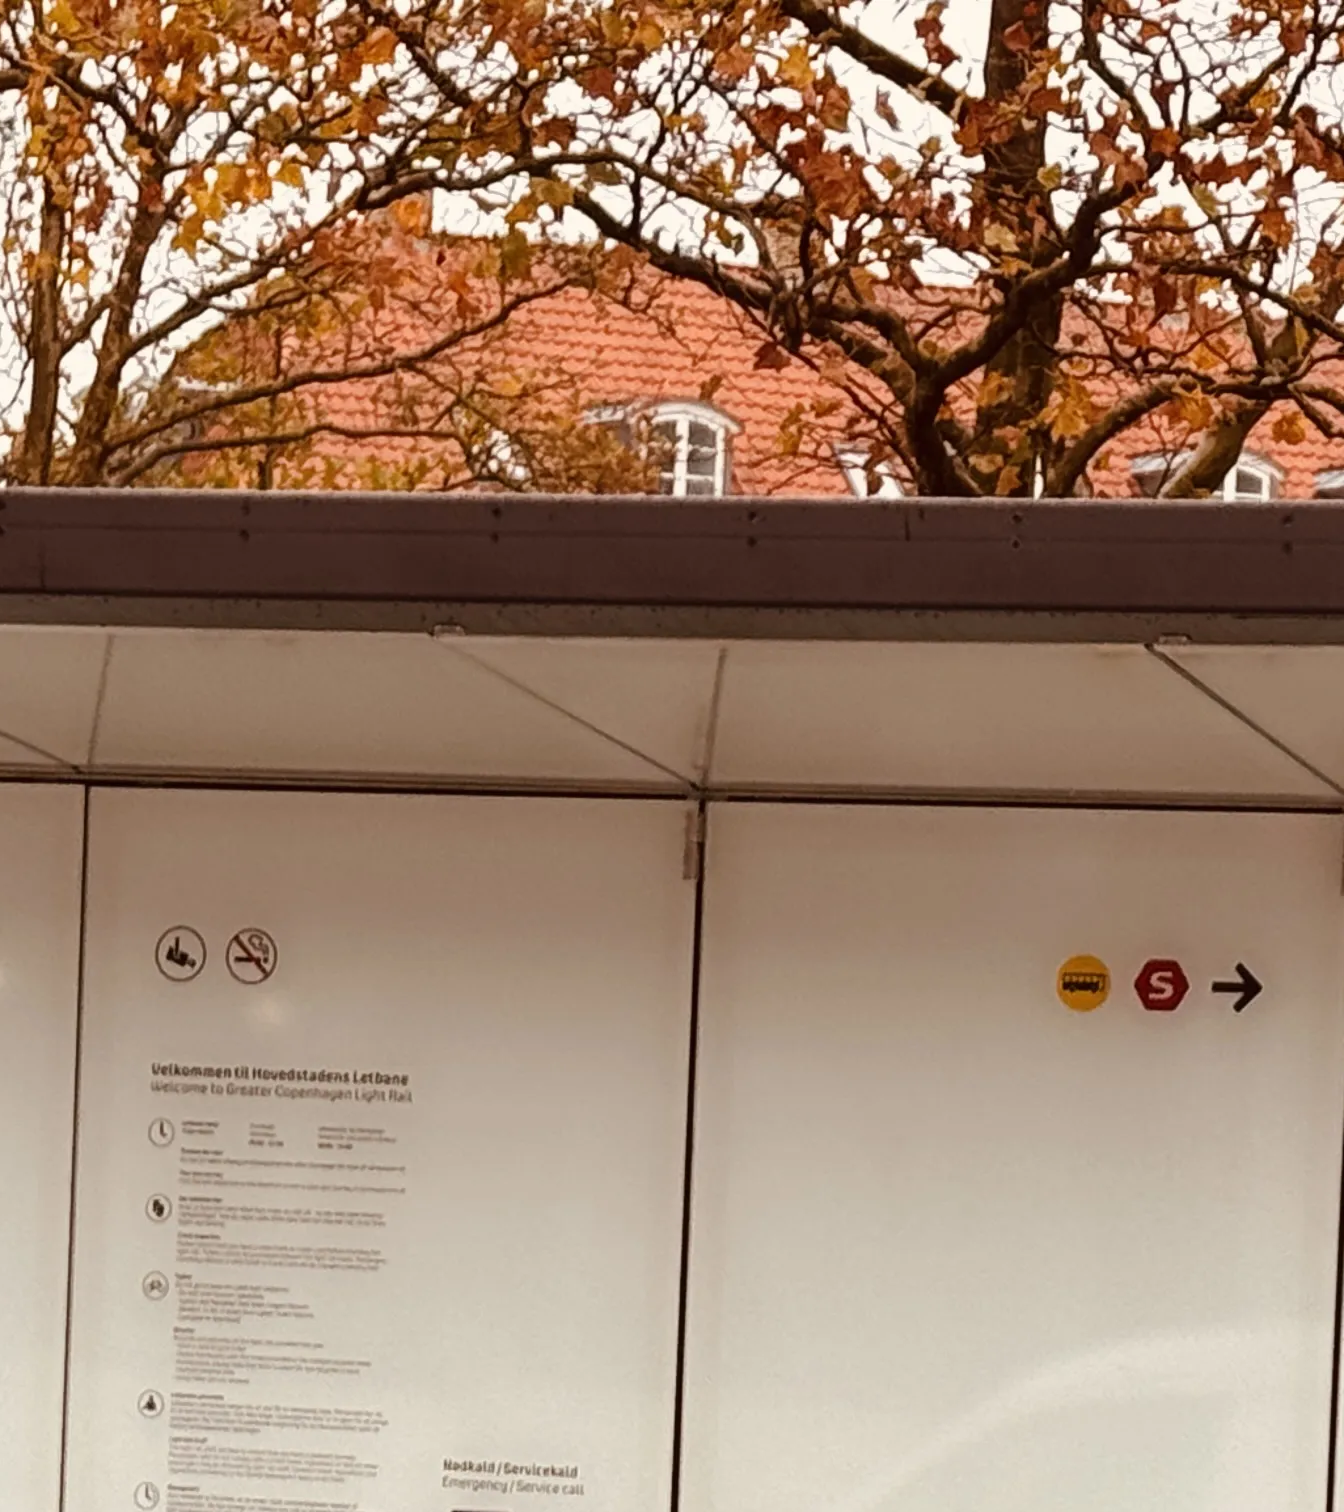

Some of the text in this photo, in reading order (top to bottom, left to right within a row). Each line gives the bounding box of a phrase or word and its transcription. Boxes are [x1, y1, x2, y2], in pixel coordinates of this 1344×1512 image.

[1148, 970, 1174, 1000] S
[150, 1062, 408, 1086] Velkommen til Hovedstadens Letbane
[150, 1080, 413, 1104] Welcome to Greater Copenhagen Light Rail
[561, 1483, 585, 1496] call
